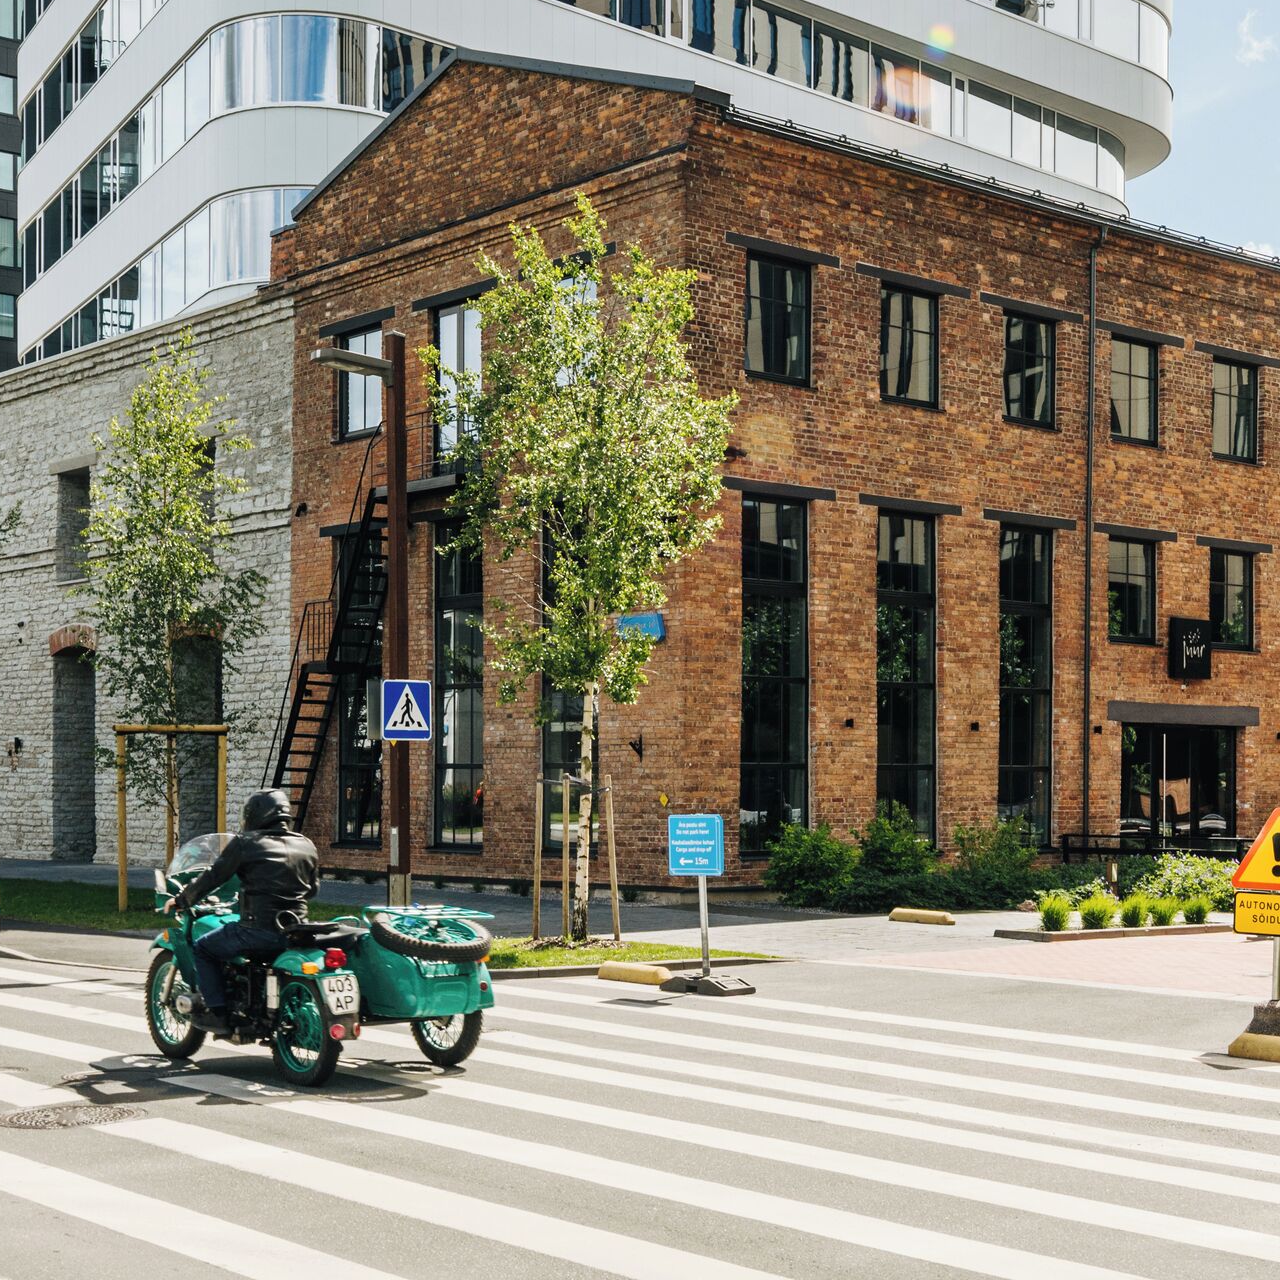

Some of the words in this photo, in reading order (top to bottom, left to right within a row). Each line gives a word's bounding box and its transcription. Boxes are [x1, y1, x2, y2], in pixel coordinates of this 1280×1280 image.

[695, 857, 709, 865] 15m
[328, 976, 354, 993] 403
[336, 995, 354, 1011] AP
